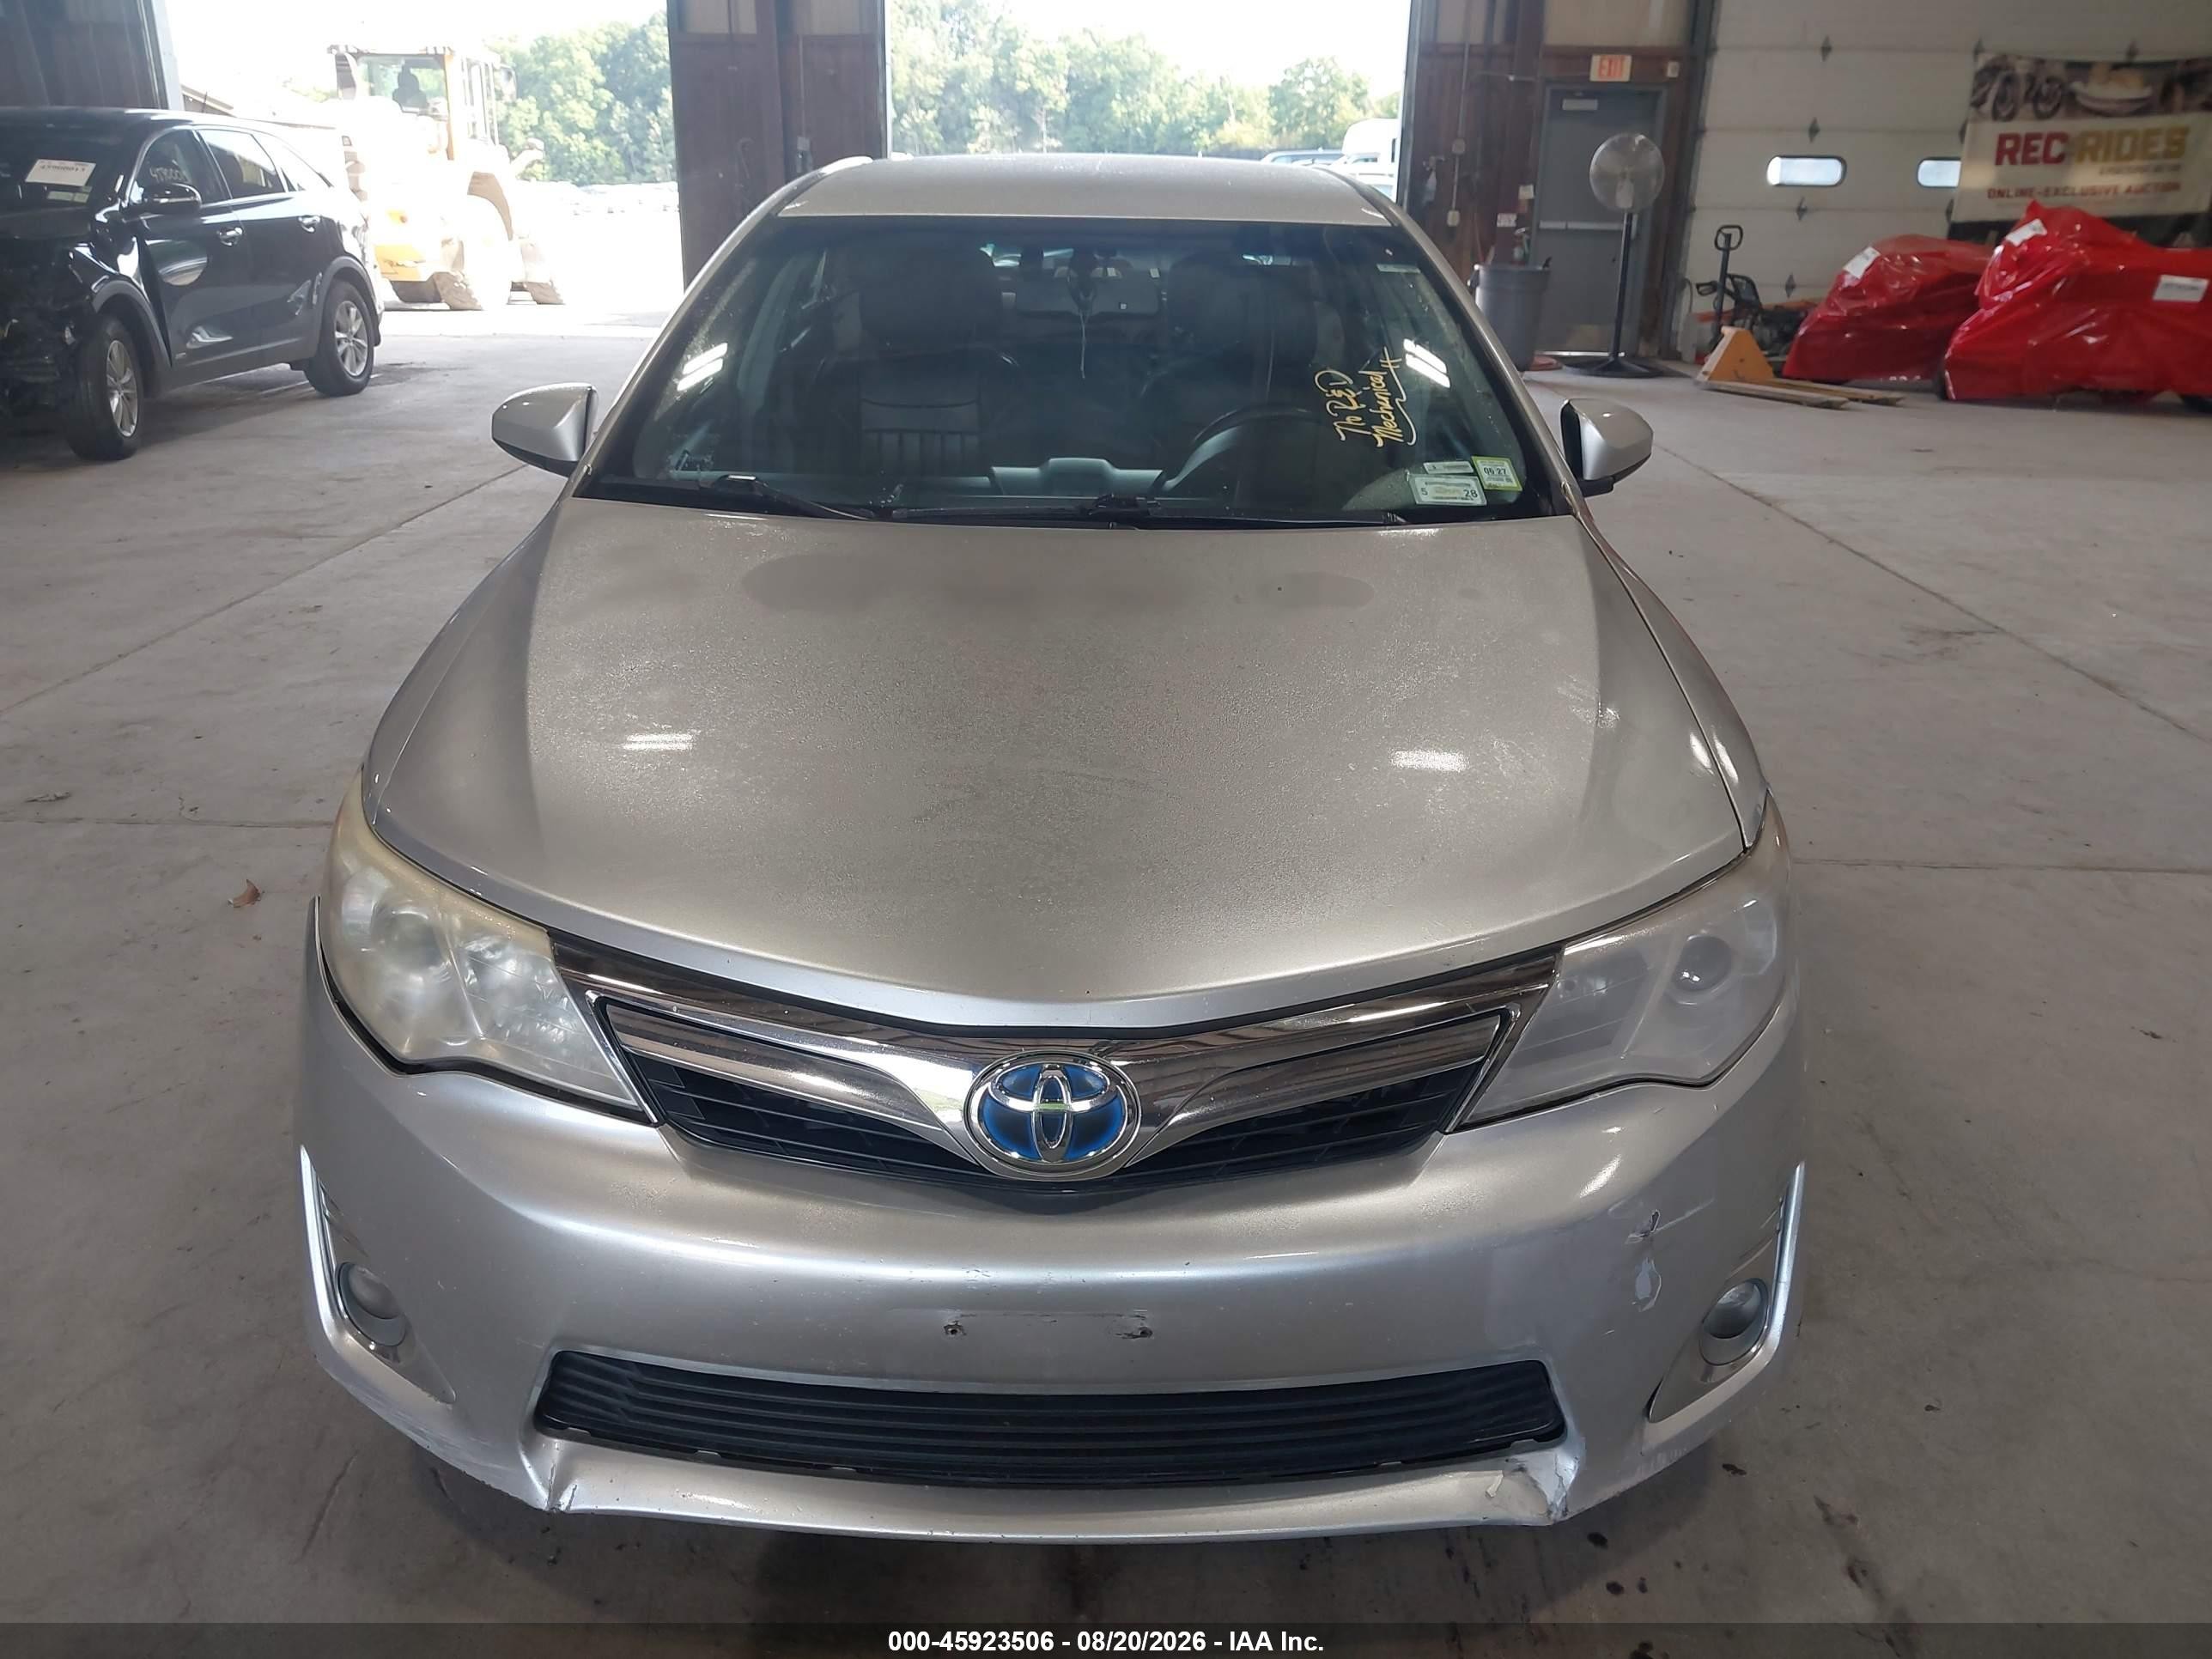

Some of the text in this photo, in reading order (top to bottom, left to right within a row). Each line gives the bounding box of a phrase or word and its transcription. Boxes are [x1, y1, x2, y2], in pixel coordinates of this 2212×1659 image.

[1995, 127, 2186, 166] REC RIDES
[1420, 487, 1428, 496] 5
[1462, 489, 1479, 499] 28
